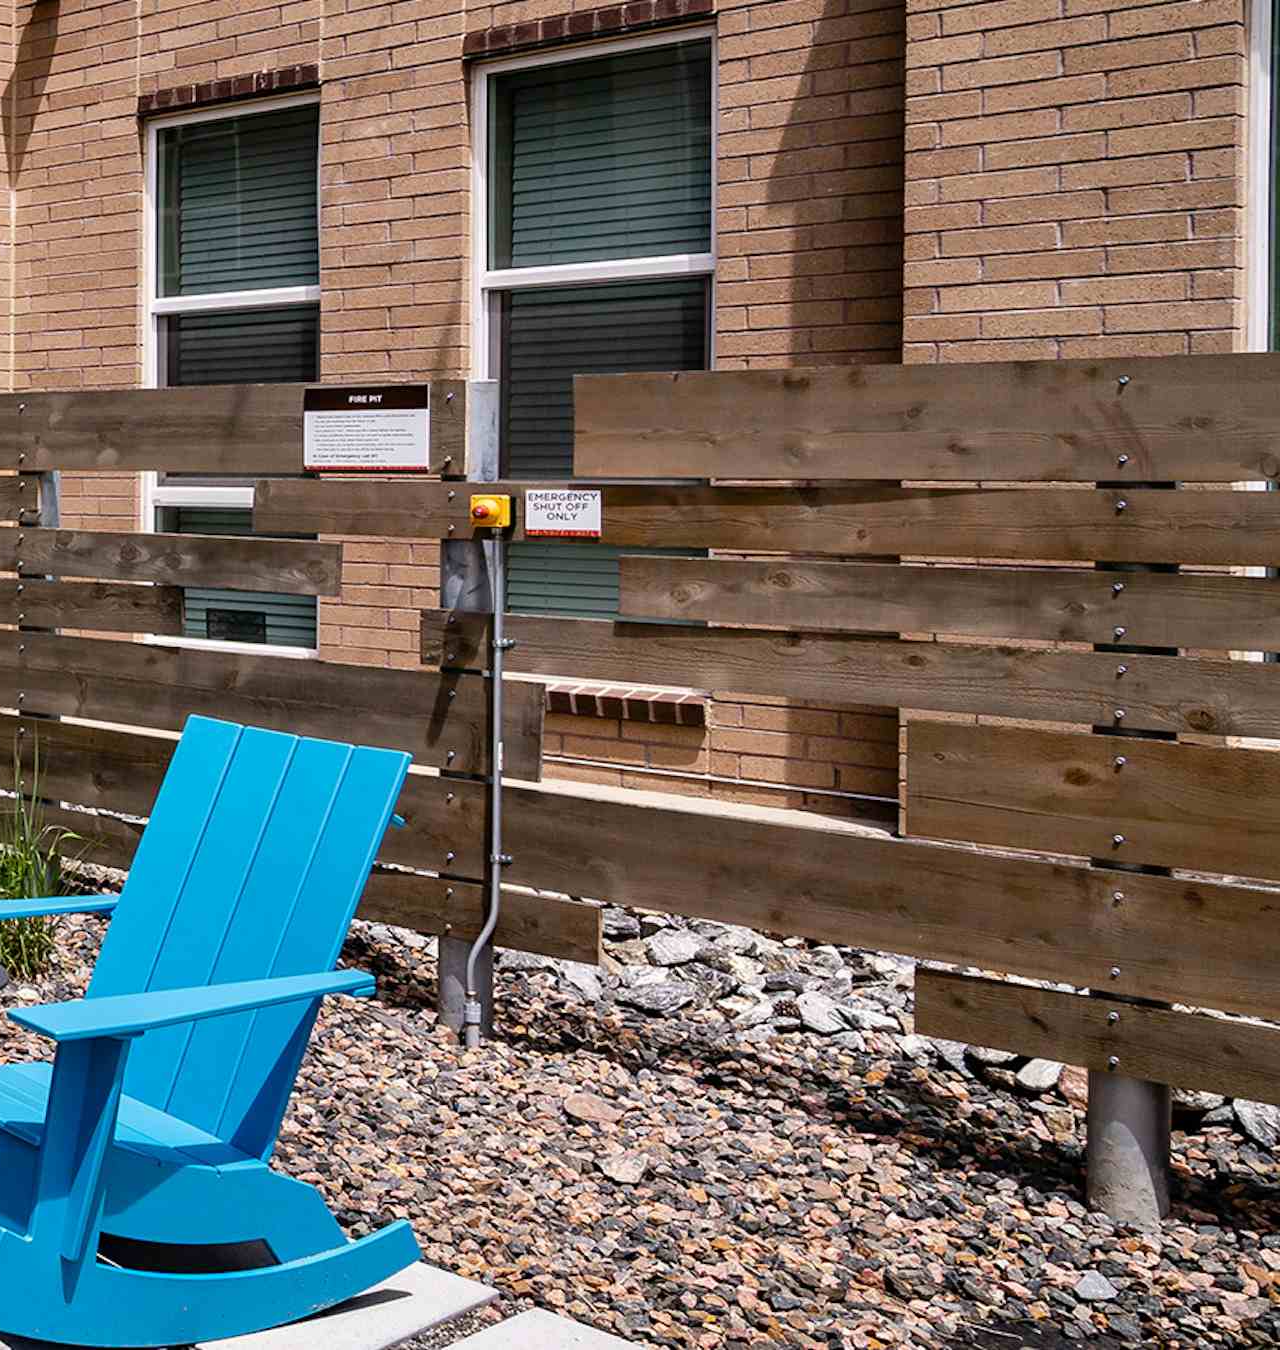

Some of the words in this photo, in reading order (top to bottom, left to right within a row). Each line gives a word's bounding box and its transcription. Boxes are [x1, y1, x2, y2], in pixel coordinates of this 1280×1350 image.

[348, 395, 367, 403] FIRE
[369, 395, 382, 403] PIT
[528, 493, 598, 502] EMERGENCY
[533, 503, 561, 511] SHUT
[565, 503, 589, 511] OFF
[546, 512, 578, 521] ONLY
